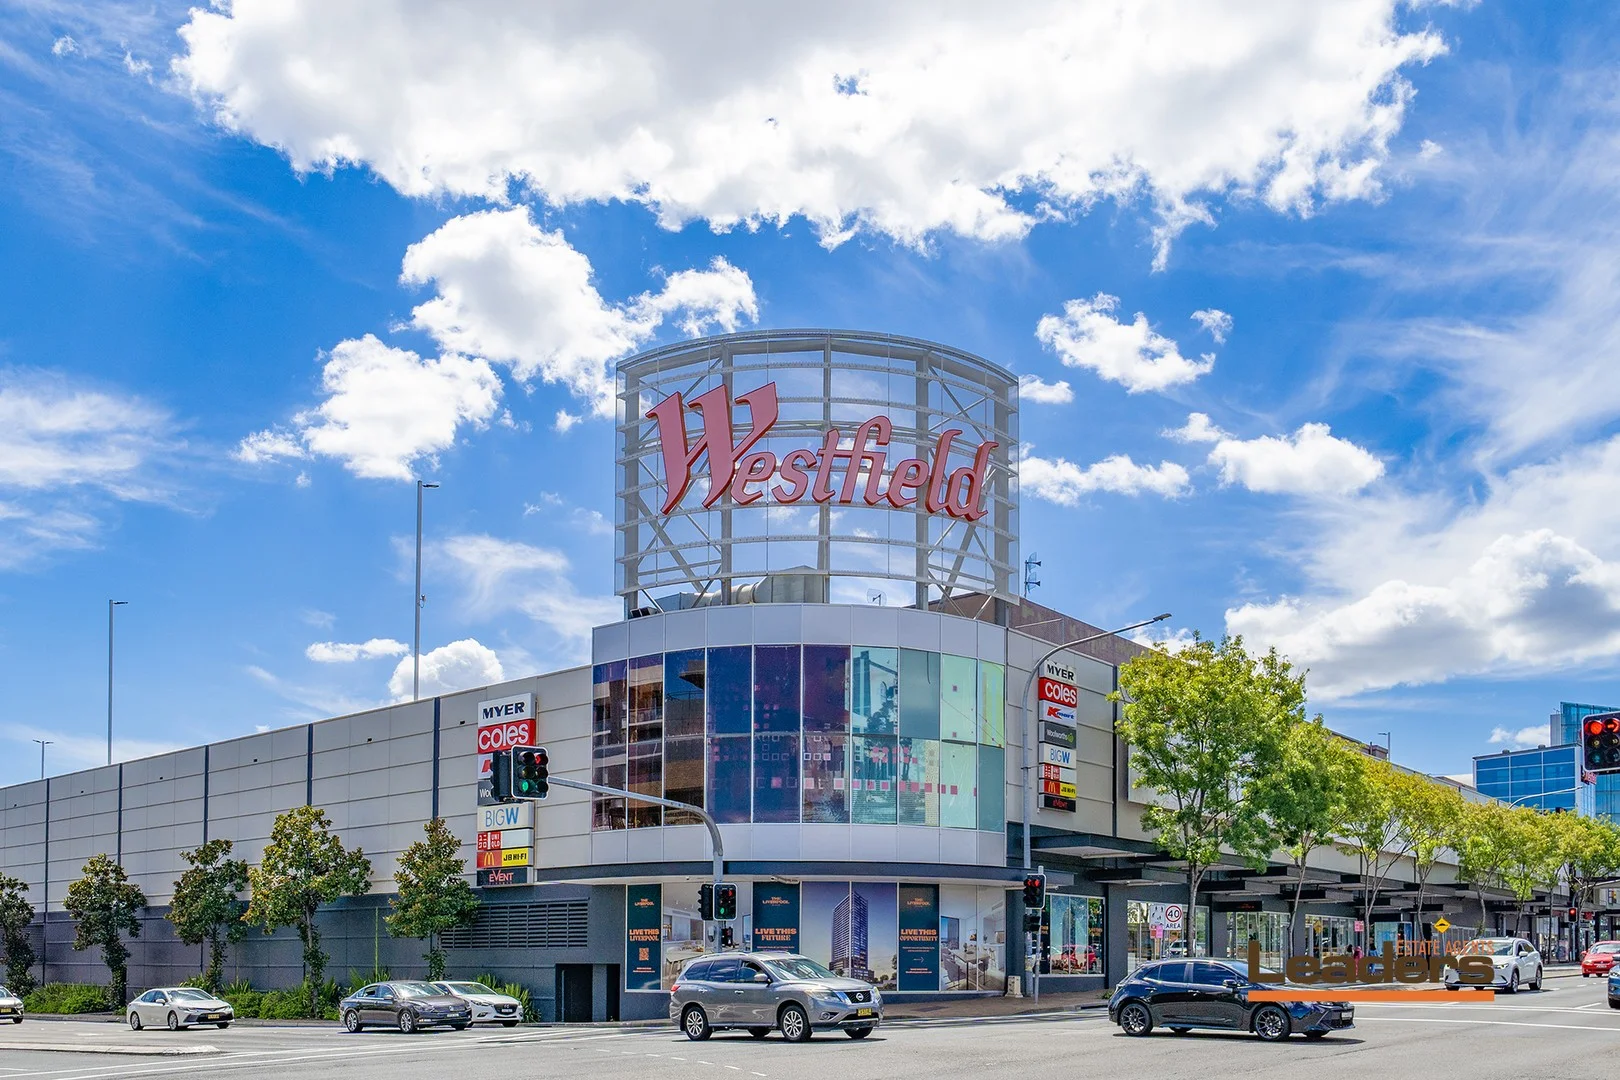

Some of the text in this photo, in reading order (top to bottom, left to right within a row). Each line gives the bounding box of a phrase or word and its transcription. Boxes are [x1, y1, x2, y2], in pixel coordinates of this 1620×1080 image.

[645, 382, 999, 522] Westfield
[1047, 664, 1074, 681] MYER
[1045, 682, 1077, 705] coles
[482, 701, 525, 719] MYER
[1047, 706, 1075, 720] Kmart
[479, 723, 529, 750] coles
[503, 853, 512, 861] JB
[488, 869, 514, 882] EVENT
[1167, 909, 1180, 919] 40
